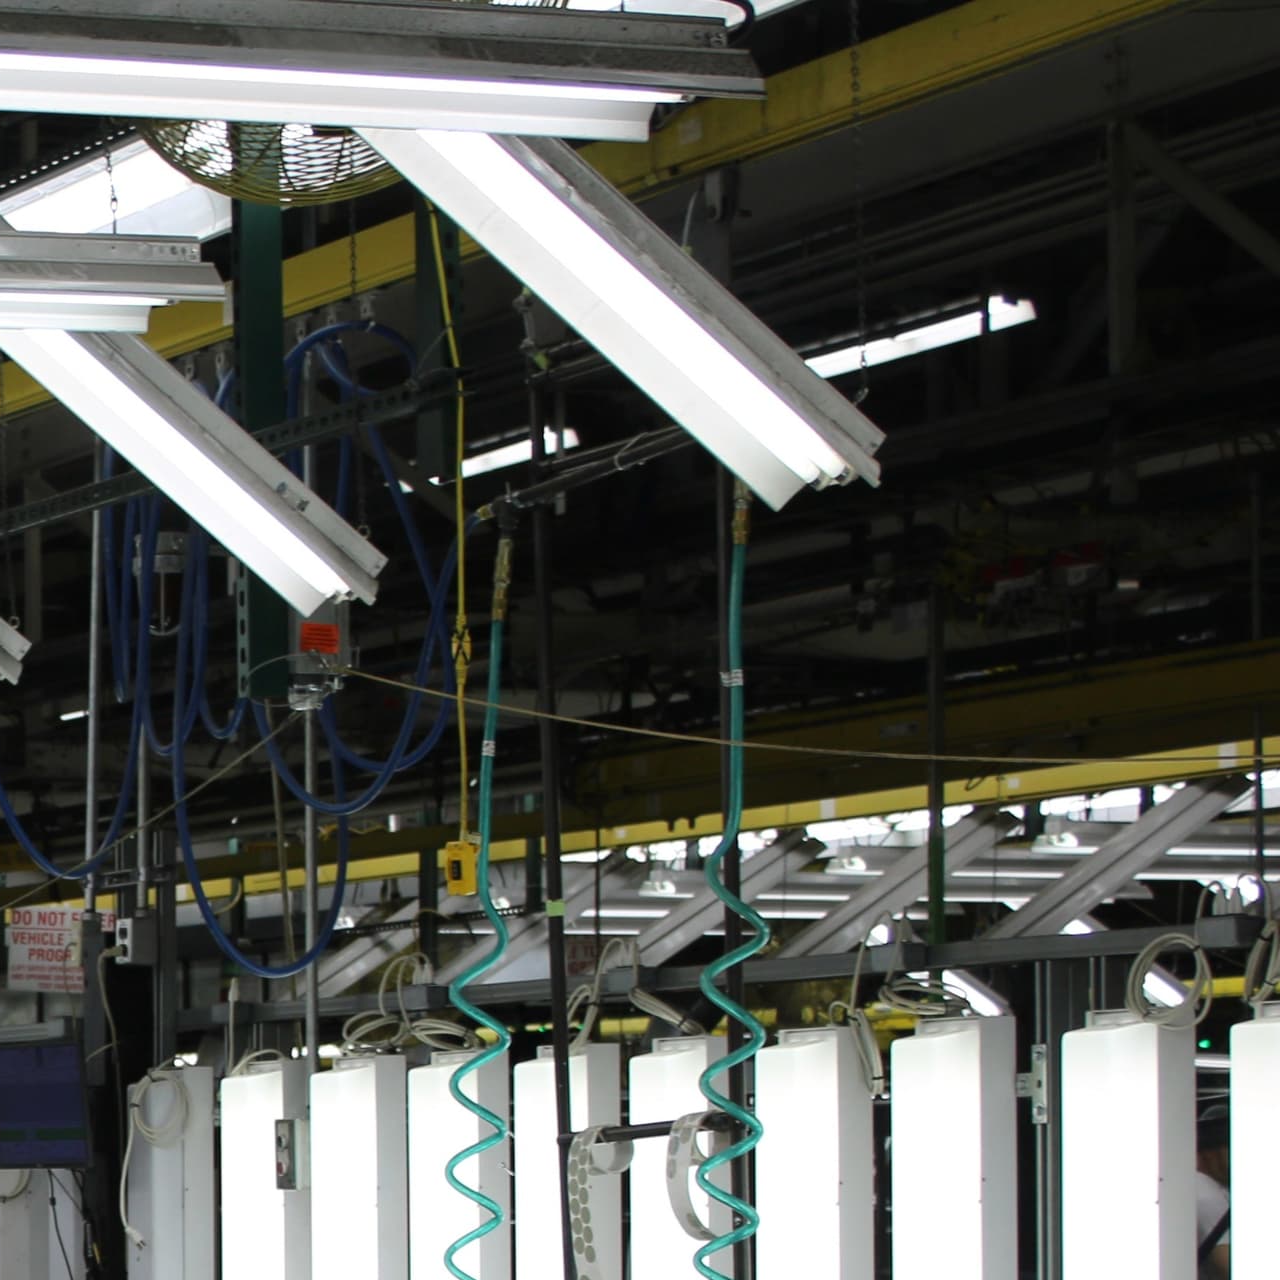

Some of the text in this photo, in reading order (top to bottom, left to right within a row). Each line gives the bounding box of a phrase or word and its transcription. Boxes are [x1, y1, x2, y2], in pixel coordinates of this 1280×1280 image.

[12, 910, 32, 926] DO
[38, 911, 66, 927] NOT
[11, 931, 65, 946] VEHICLE
